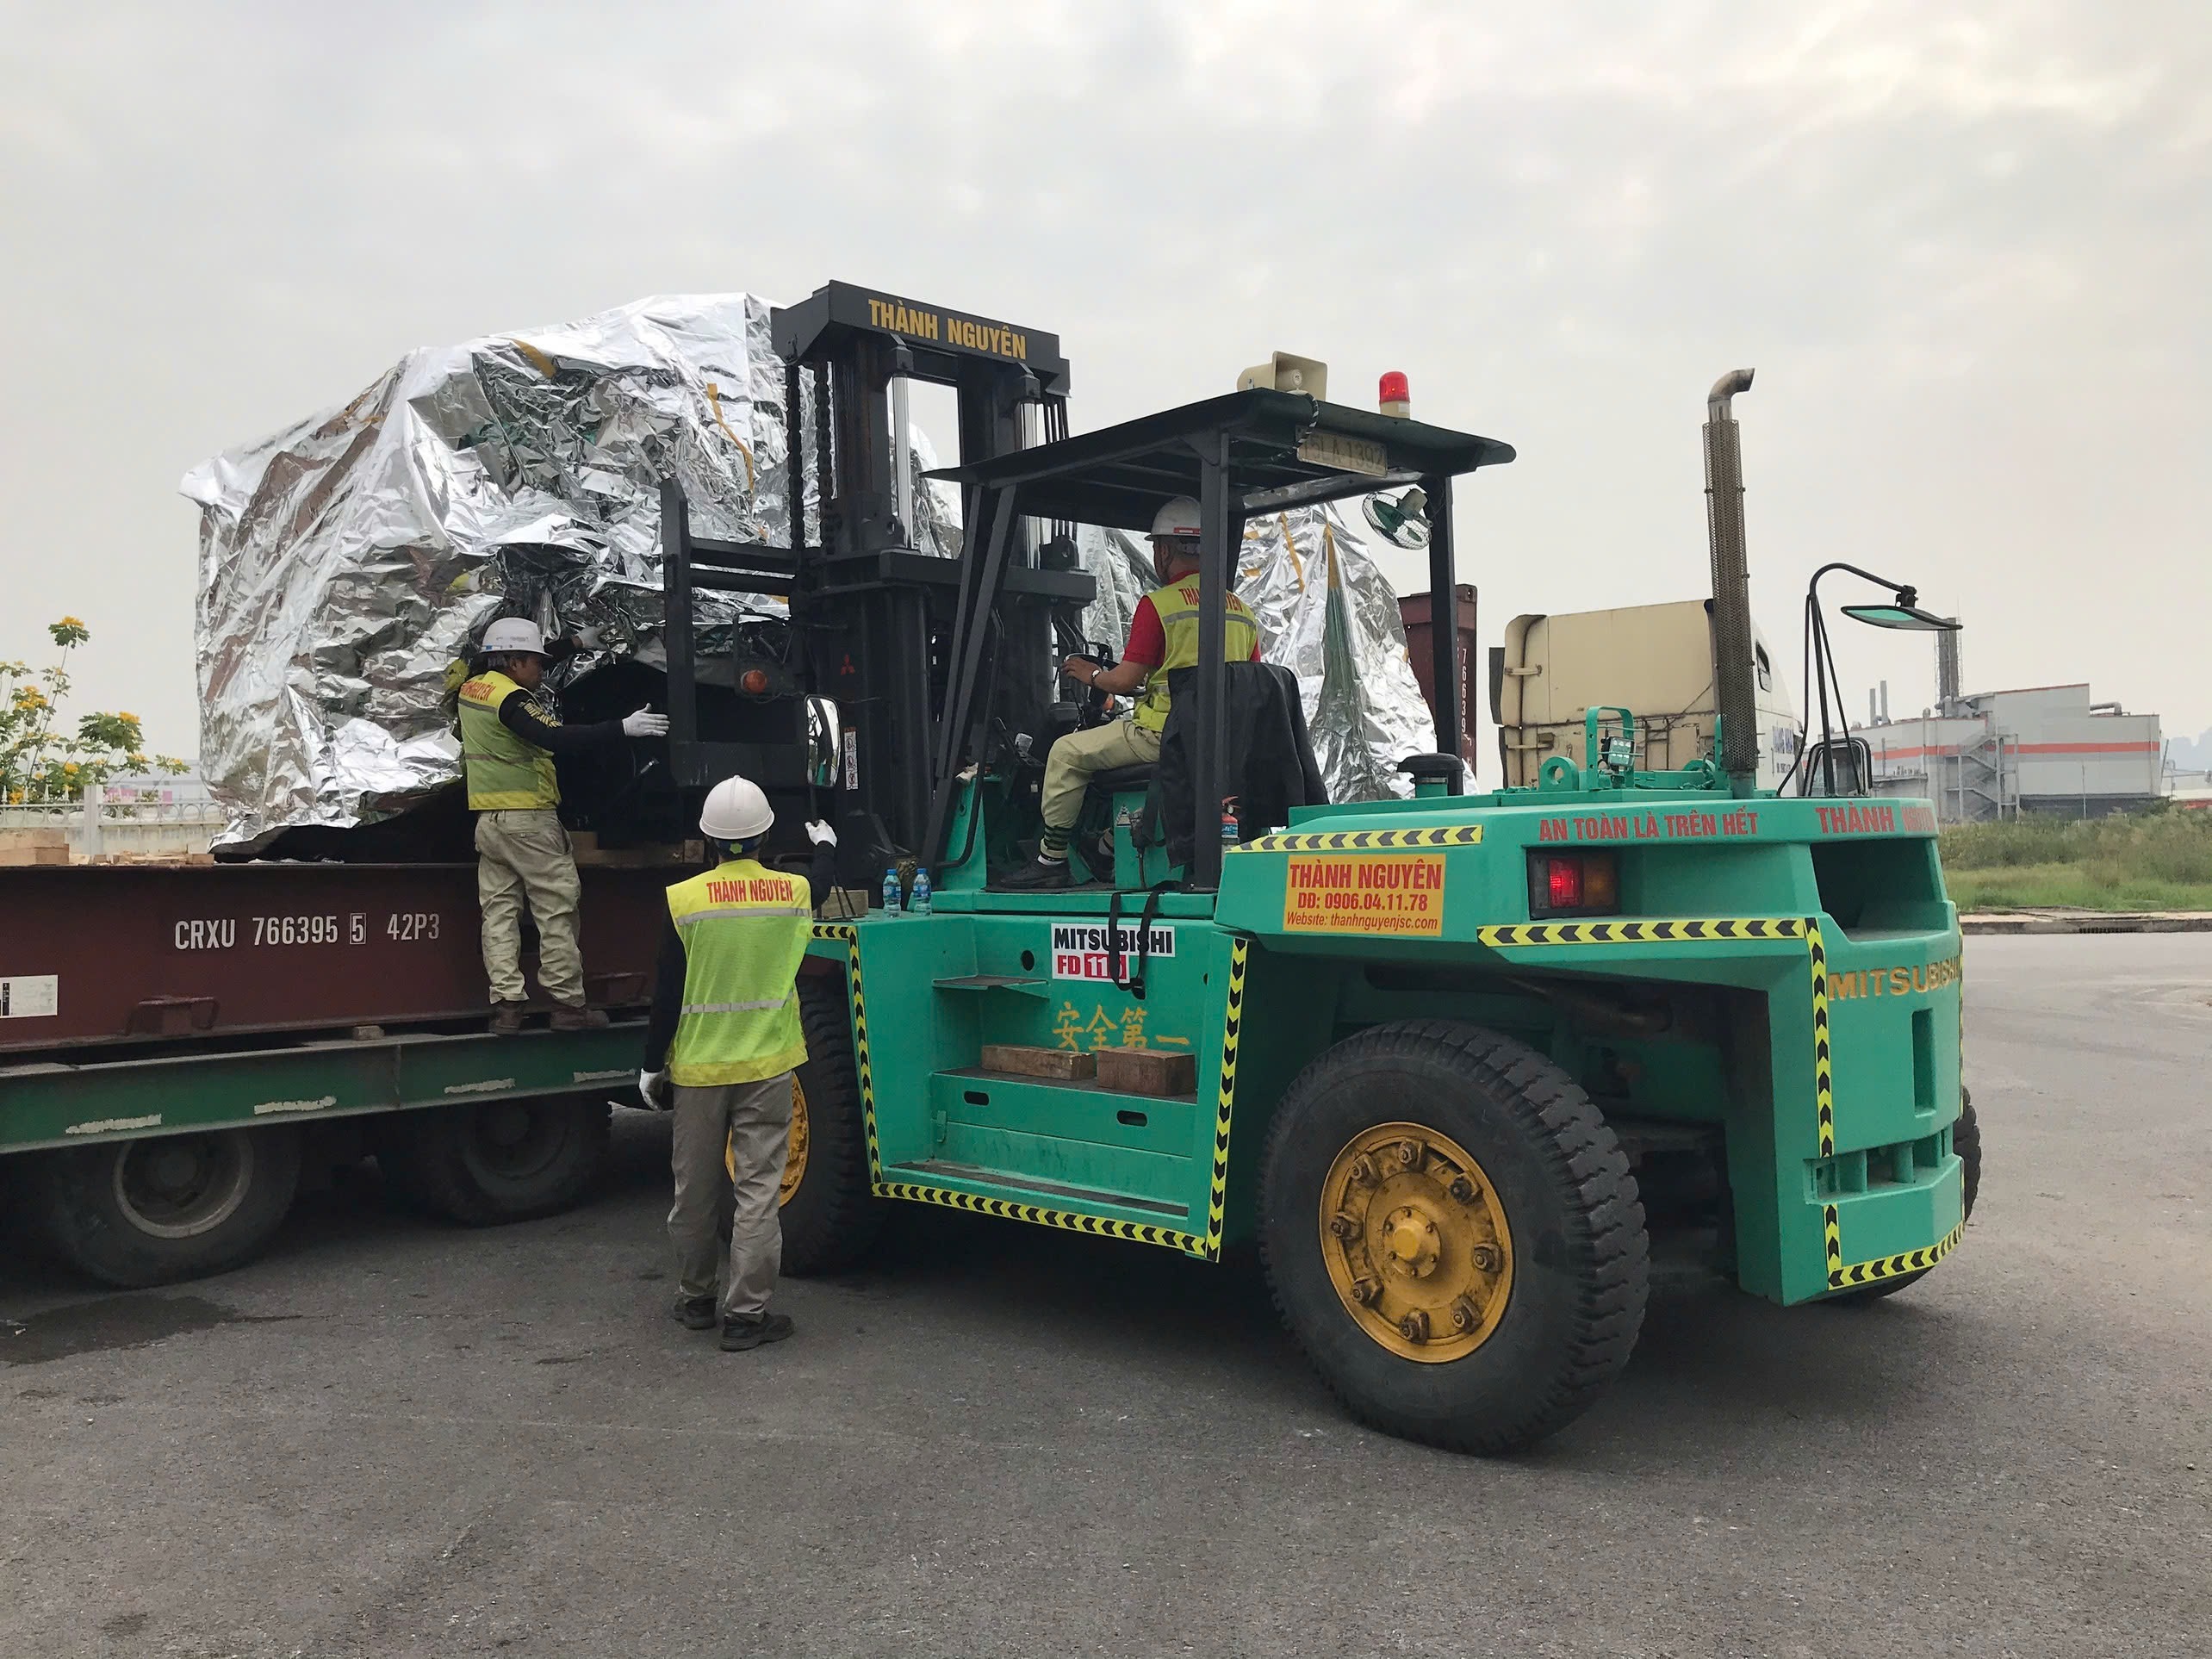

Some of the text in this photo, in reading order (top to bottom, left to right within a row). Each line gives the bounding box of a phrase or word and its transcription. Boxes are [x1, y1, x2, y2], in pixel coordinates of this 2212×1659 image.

[868, 299, 1027, 360] THÀNH NGUYÊN
[1178, 585, 1199, 606] THÀ
[1539, 805, 1758, 842] AN TOÀN LÀ TRÊN HẾT
[1815, 801, 1895, 834] THÀNH
[706, 877, 747, 903] THÀNH
[1289, 858, 1442, 890] THÀNH NGUYÊN
[1325, 892, 1428, 911] 0906.04.11.78
[175, 913, 440, 950] CRXU 766395 5 42P3
[1287, 911, 1438, 931] Website: thanhnguyenjsc.com
[1057, 954, 1124, 978] FD 11
[1053, 1000, 1190, 1053] 安全第一
